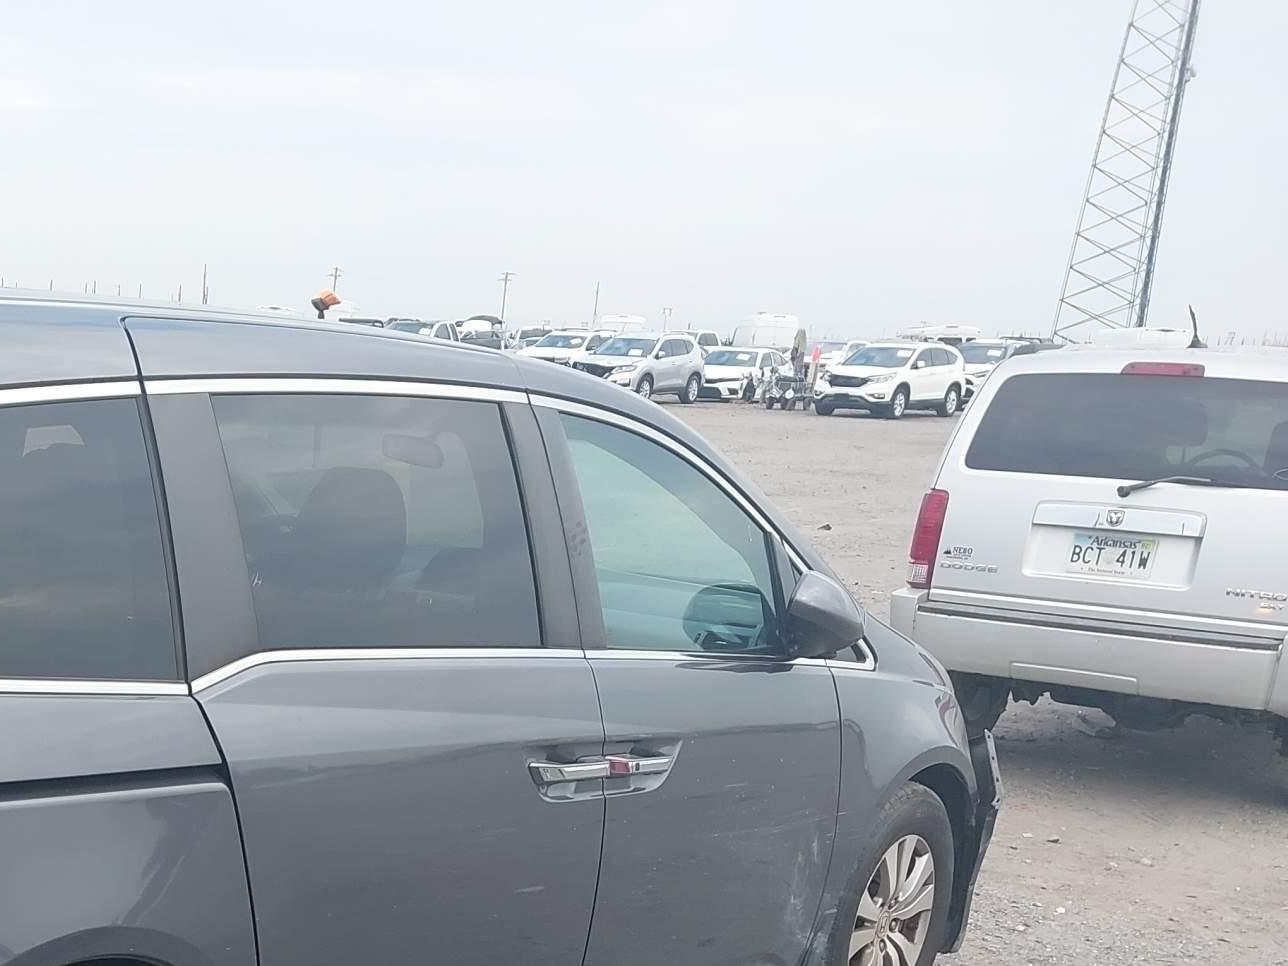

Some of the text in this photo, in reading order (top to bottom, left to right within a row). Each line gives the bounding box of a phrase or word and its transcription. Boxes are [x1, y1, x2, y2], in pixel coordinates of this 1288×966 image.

[1090, 535, 1139, 550] Arkansas
[1070, 544, 1151, 570] BCT 41W
[940, 560, 999, 574] DODGE
[1224, 587, 1287, 602] NITRO
